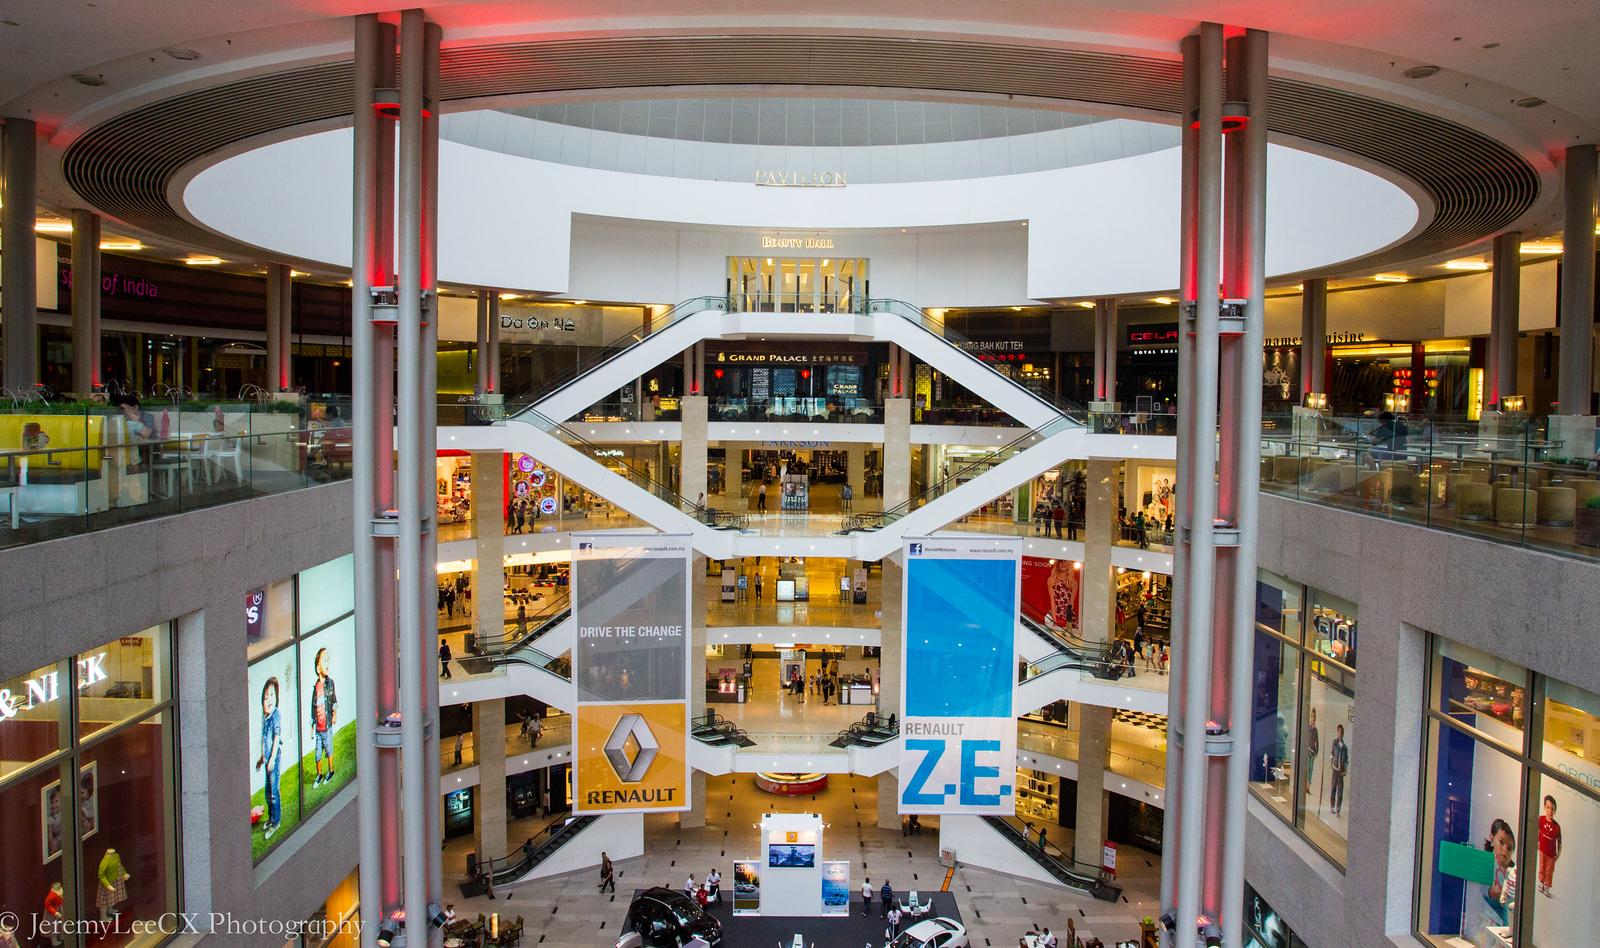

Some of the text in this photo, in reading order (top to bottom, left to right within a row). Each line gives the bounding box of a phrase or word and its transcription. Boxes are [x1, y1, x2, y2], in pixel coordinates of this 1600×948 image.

[755, 170, 846, 185] PAVILION
[762, 236, 834, 248] BEAUTY HALL
[102, 274, 158, 298] of india
[501, 315, 549, 330] Da On
[1131, 331, 1178, 341] CELA
[1264, 336, 1302, 347] names
[1325, 331, 1365, 344] uisine
[980, 341, 994, 350] BAH
[995, 341, 1009, 350] KUT
[1010, 341, 1024, 350] TEH
[729, 354, 766, 362] GRAND
[769, 354, 808, 362] PALACE
[580, 625, 682, 638] DRIVE THE CHANGE
[905, 722, 965, 736] RENAULT
[587, 788, 677, 804] RENAULT
